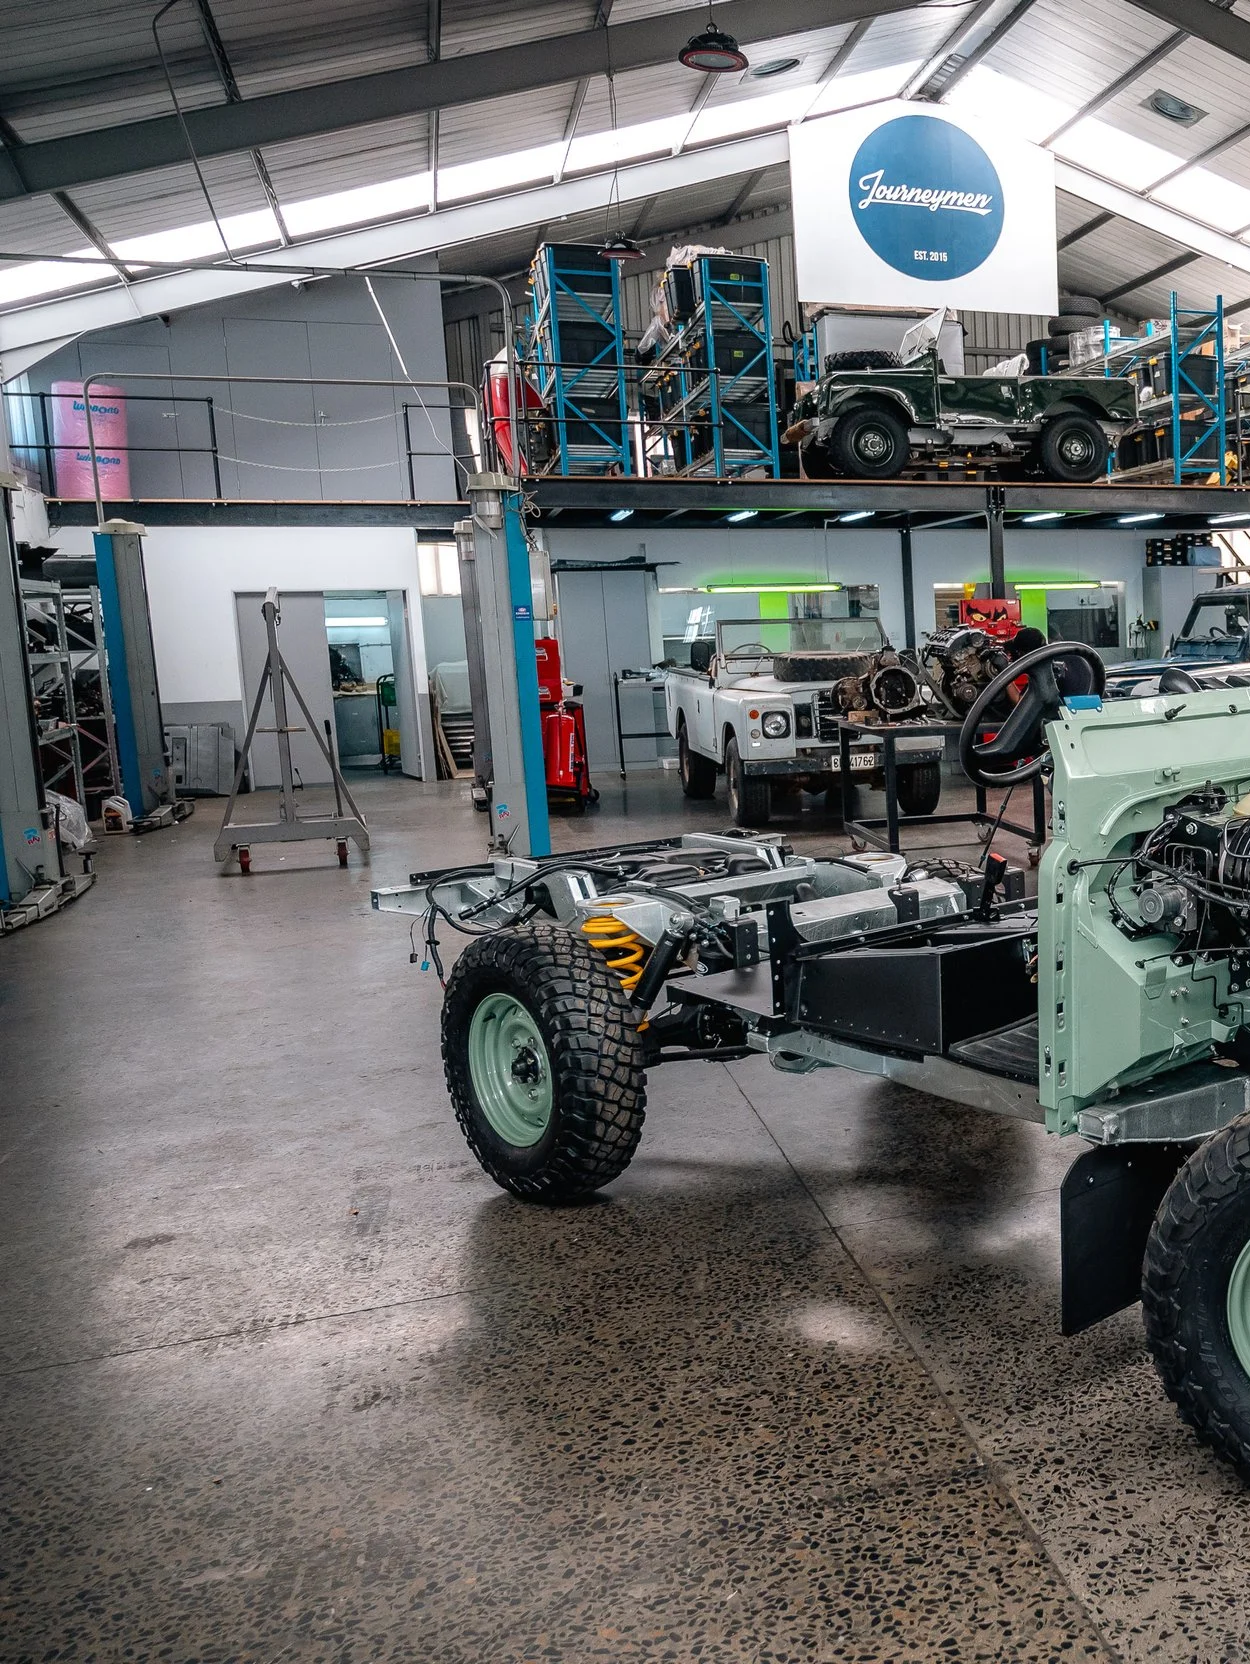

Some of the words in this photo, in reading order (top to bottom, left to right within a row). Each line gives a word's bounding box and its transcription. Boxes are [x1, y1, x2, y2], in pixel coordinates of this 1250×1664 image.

[858, 169, 993, 215] Journeymen
[914, 250, 929, 261] EST.
[930, 251, 948, 262] 2015
